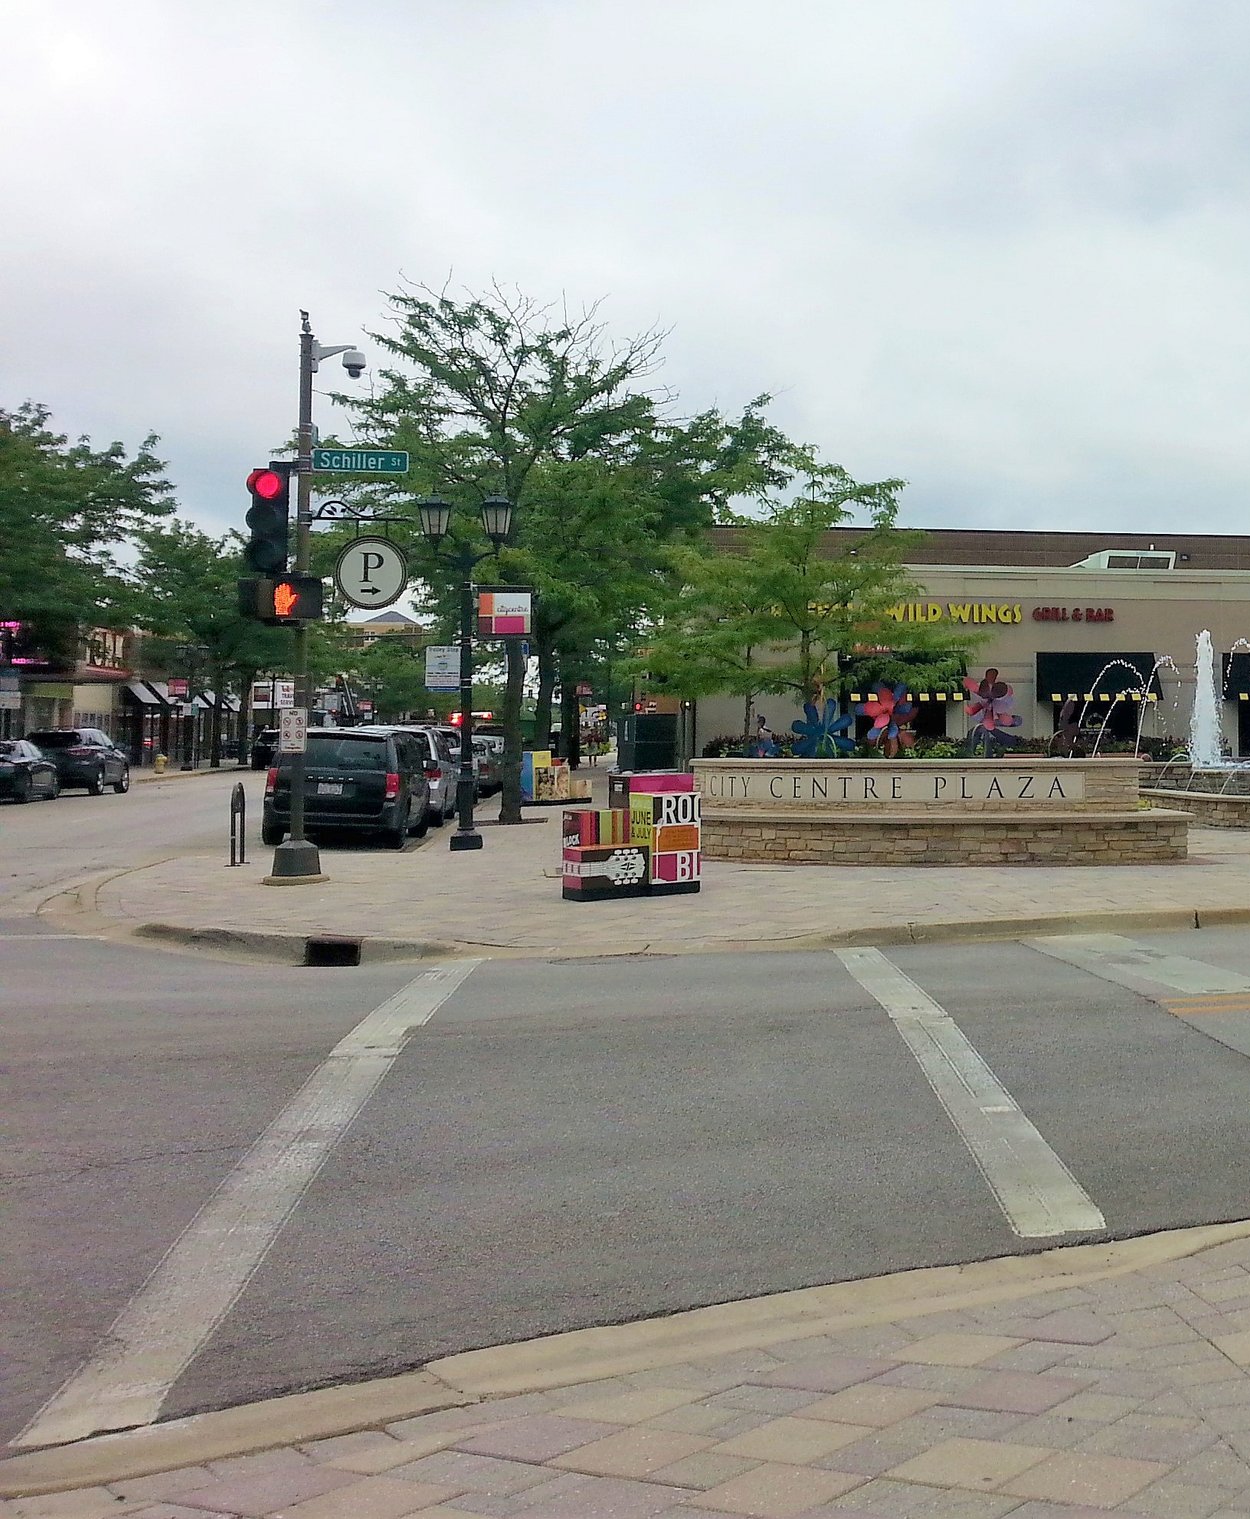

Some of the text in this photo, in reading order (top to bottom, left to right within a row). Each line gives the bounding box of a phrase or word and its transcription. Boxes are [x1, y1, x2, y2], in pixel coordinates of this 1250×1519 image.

[320, 451, 401, 469] Schiller St
[359, 552, 384, 583] P
[886, 603, 1022, 624] WILD WINGS
[1032, 606, 1115, 622] GRILL & BAR
[709, 775, 1067, 799] CITY CENTRE PLAZA
[631, 810, 651, 826] JUNE
[637, 827, 652, 840] JULY
